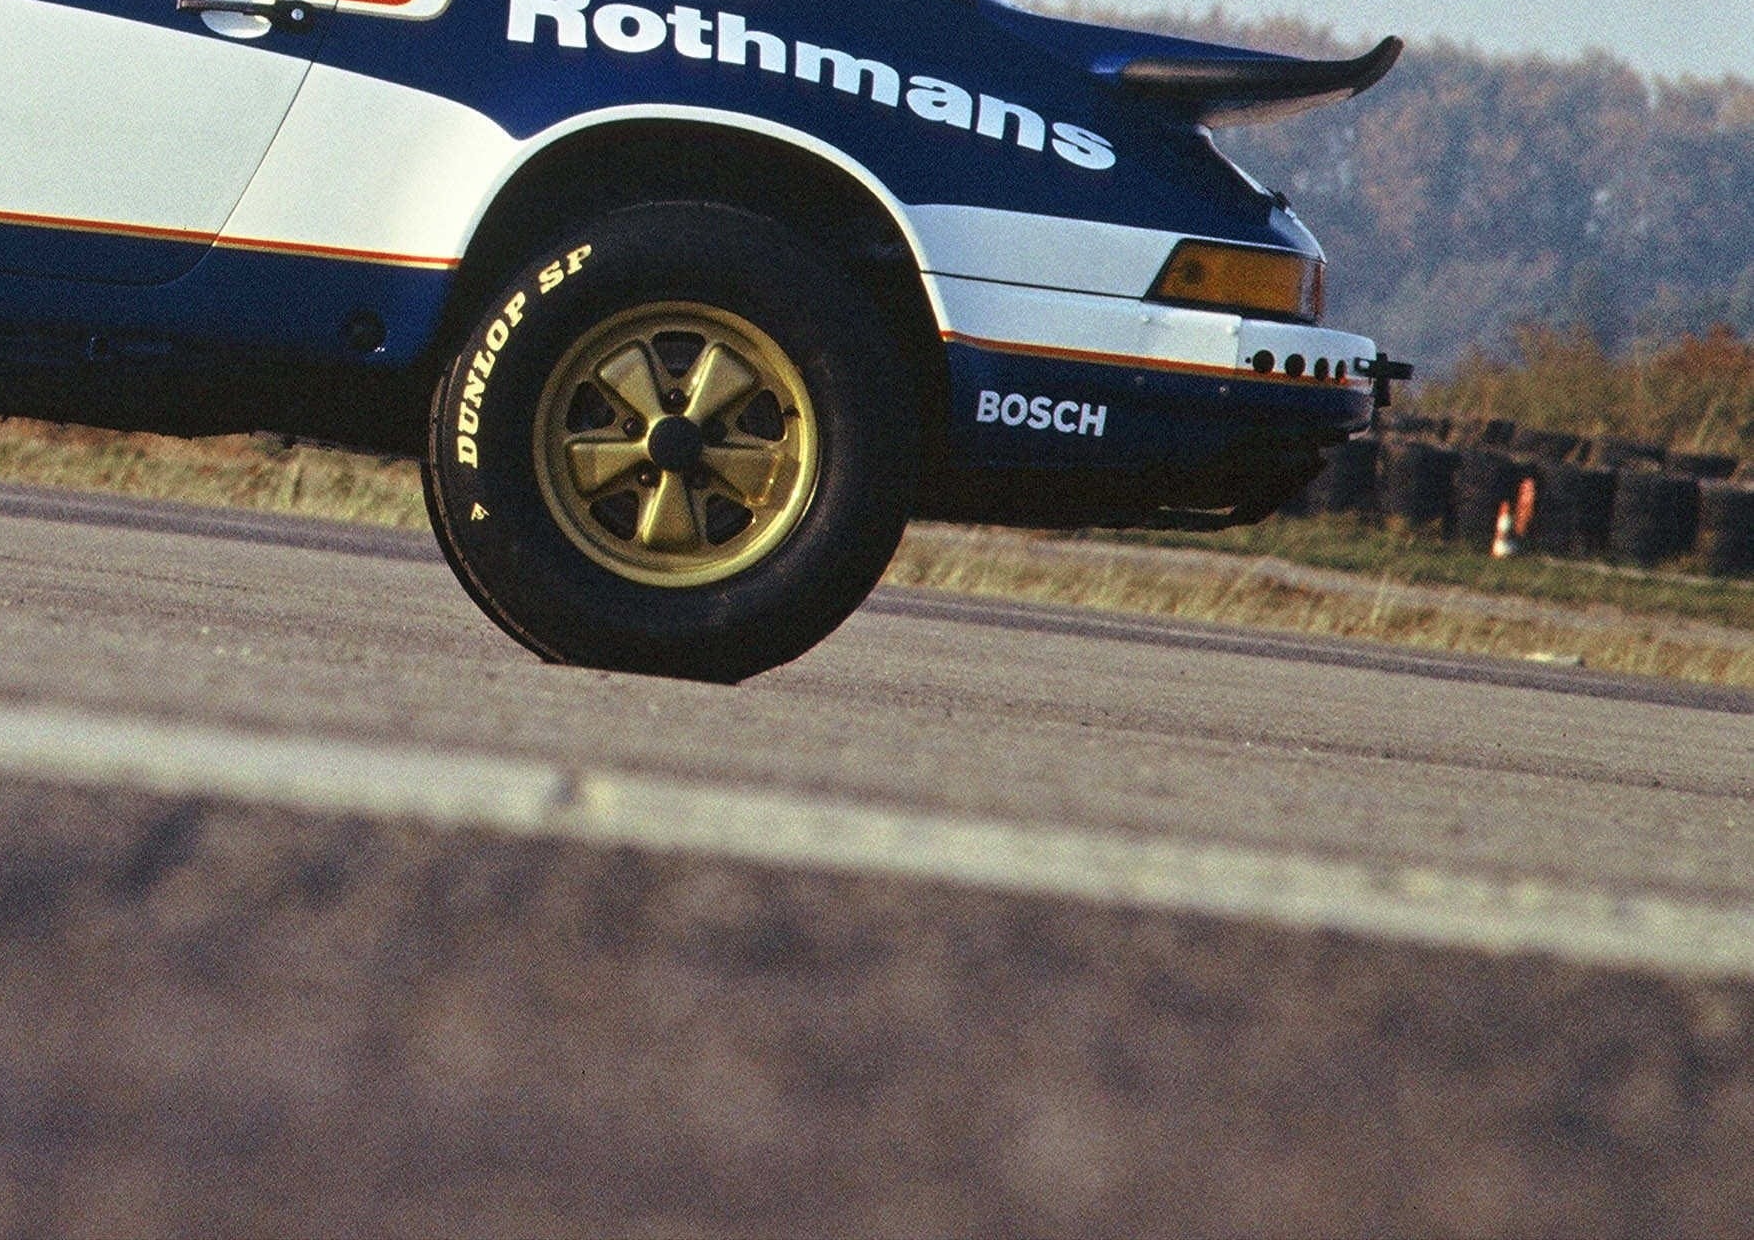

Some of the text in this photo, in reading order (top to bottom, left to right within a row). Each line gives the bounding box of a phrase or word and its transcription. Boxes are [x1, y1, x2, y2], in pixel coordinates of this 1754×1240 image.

[457, 244, 592, 468] DUNLOP SP
[976, 391, 1107, 436] BOSCH
